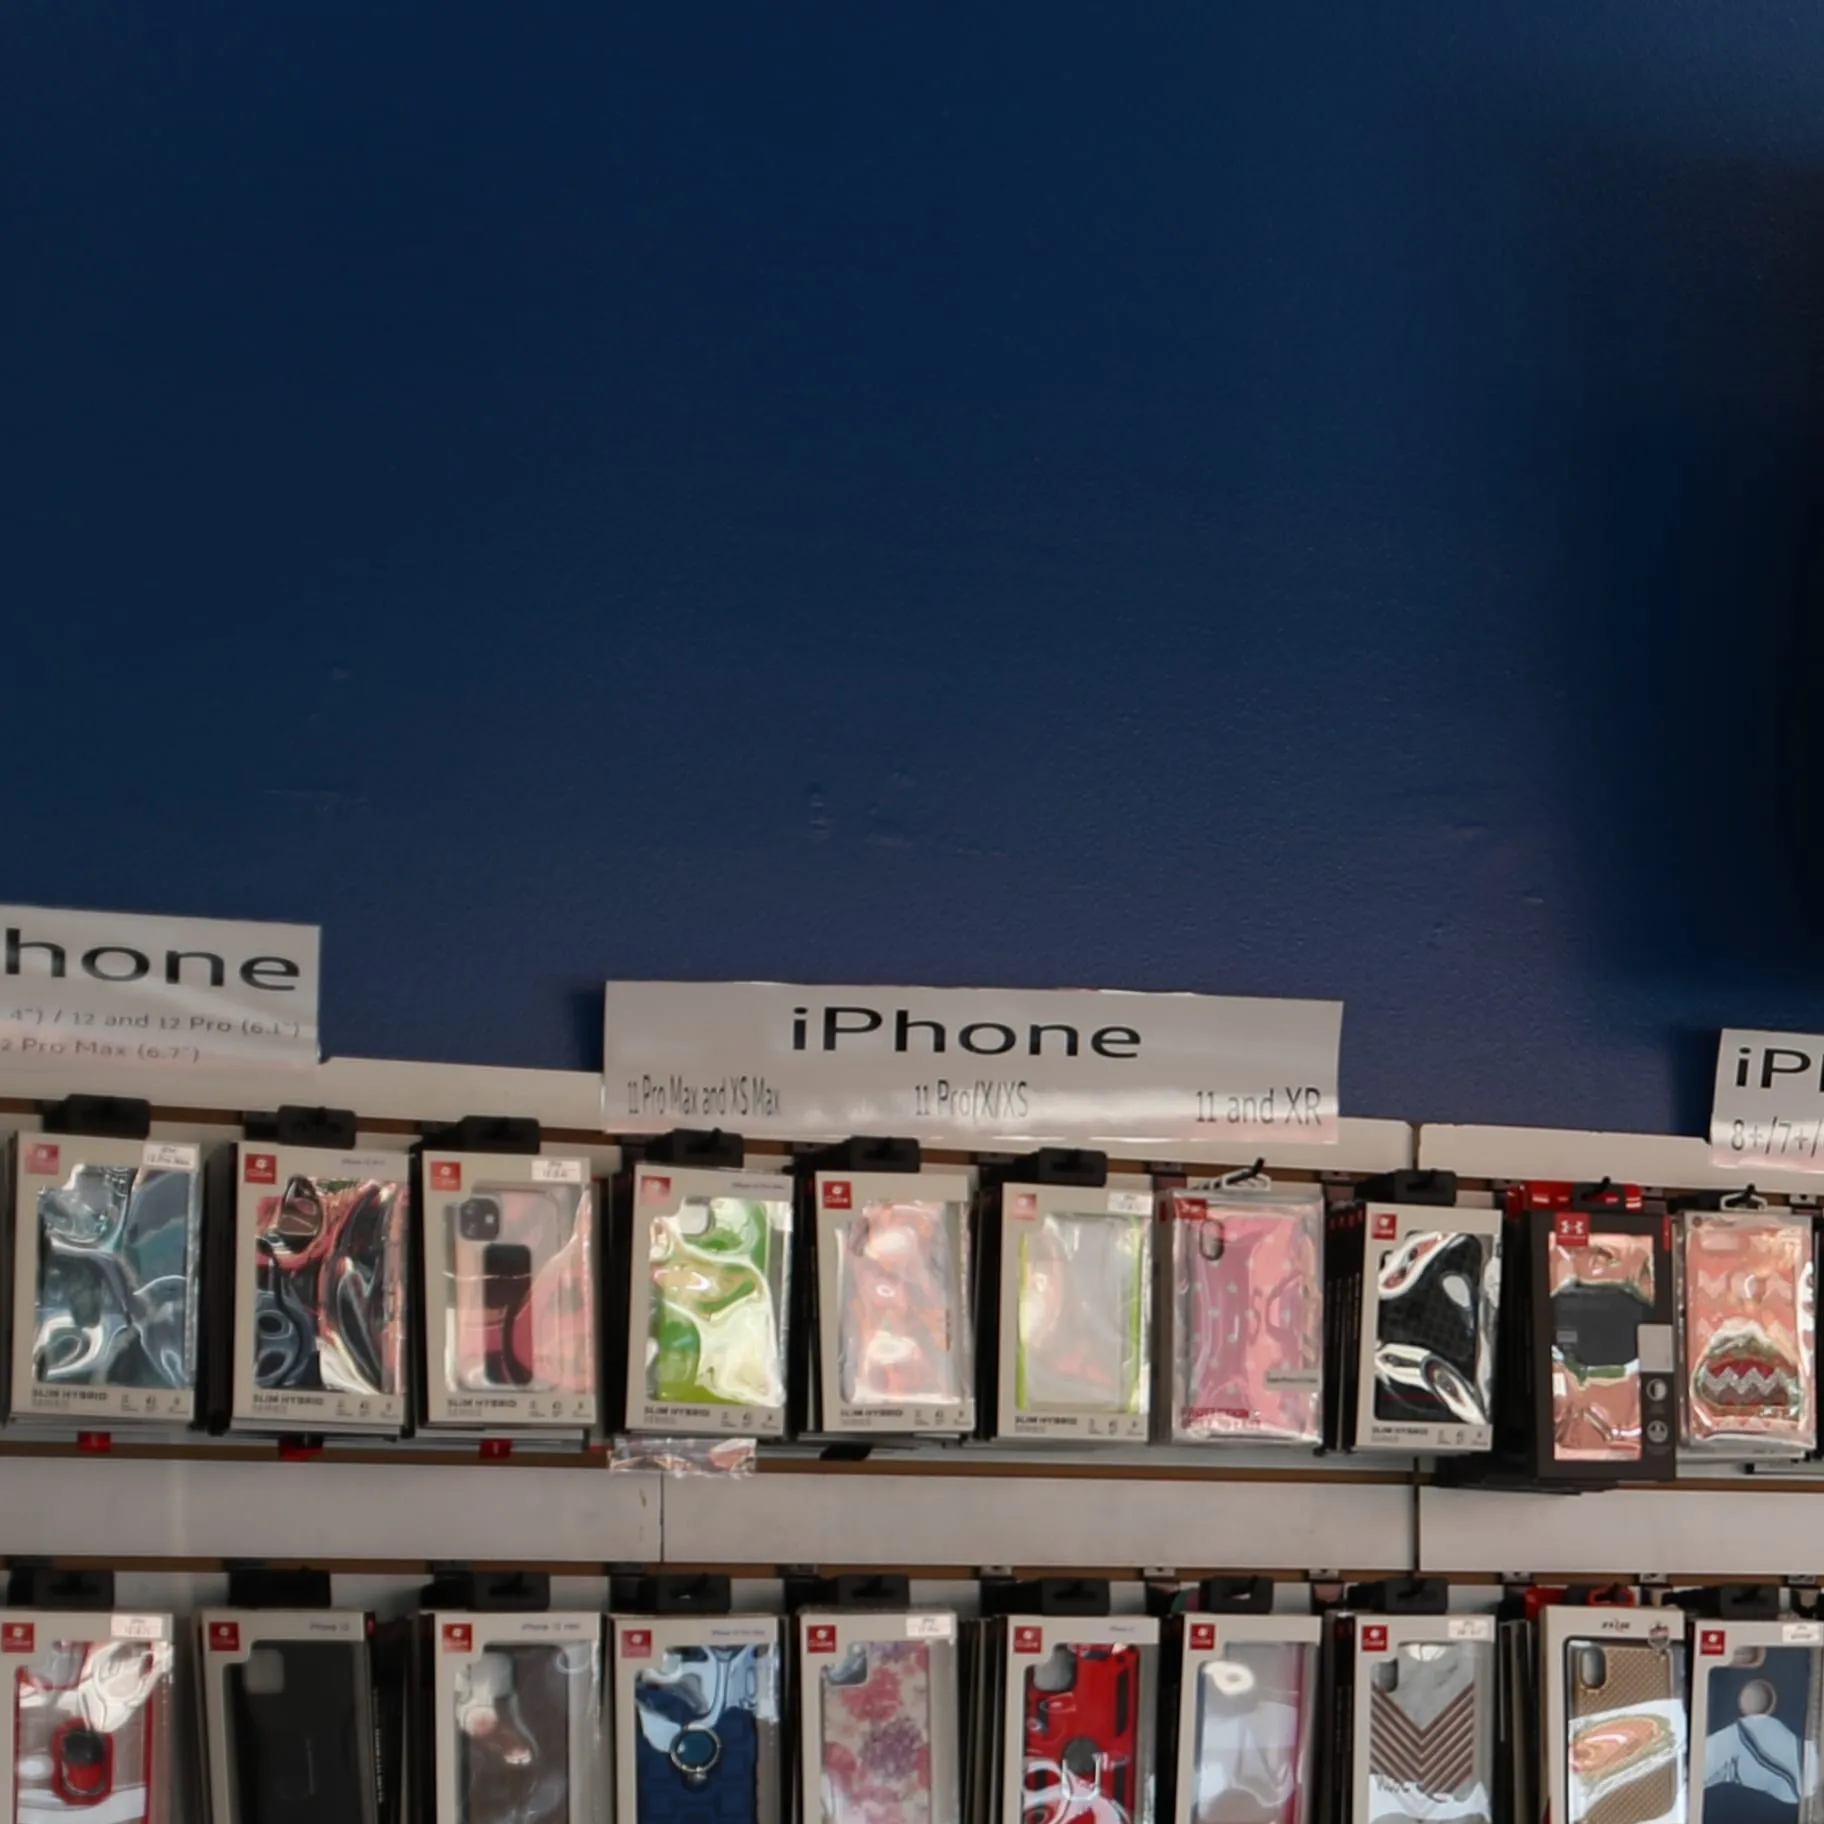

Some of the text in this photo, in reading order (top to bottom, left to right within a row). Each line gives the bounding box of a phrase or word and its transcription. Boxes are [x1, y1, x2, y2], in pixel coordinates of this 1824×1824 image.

[72, 1012, 95, 1026] 12
[104, 1013, 149, 1029] and
[160, 1017, 180, 1030] 12
[190, 1016, 232, 1032] Pro
[791, 1005, 1142, 1060] iPhone
[21, 1037, 65, 1055] Pro
[75, 1040, 126, 1058] Max
[627, 1074, 781, 1117] 11 Pro Max and XS Max
[914, 1078, 1029, 1123] 11 Pro/X/XS
[1195, 1087, 1322, 1126] 11 and XR
